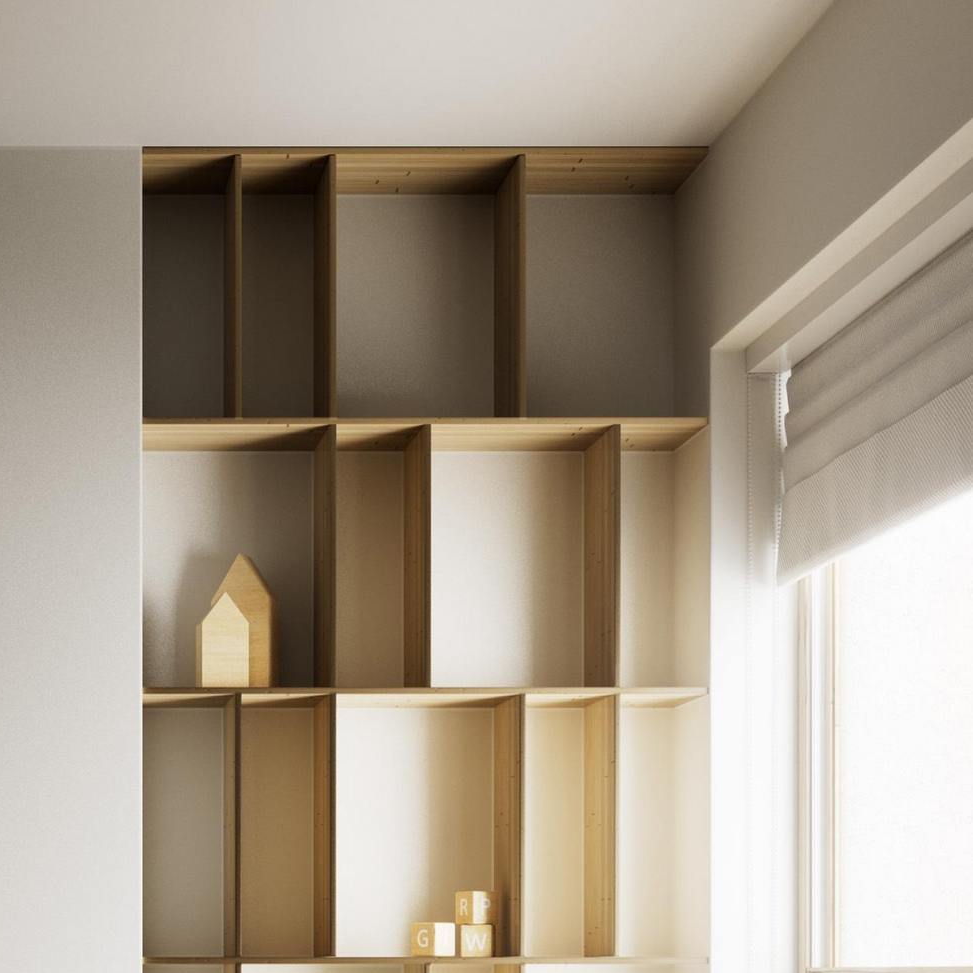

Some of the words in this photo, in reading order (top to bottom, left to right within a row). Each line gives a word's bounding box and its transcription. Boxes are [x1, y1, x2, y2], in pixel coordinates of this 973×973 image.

[459, 898, 468, 917] R
[481, 897, 491, 916] P
[416, 928, 429, 948] G
[464, 931, 487, 952] W
